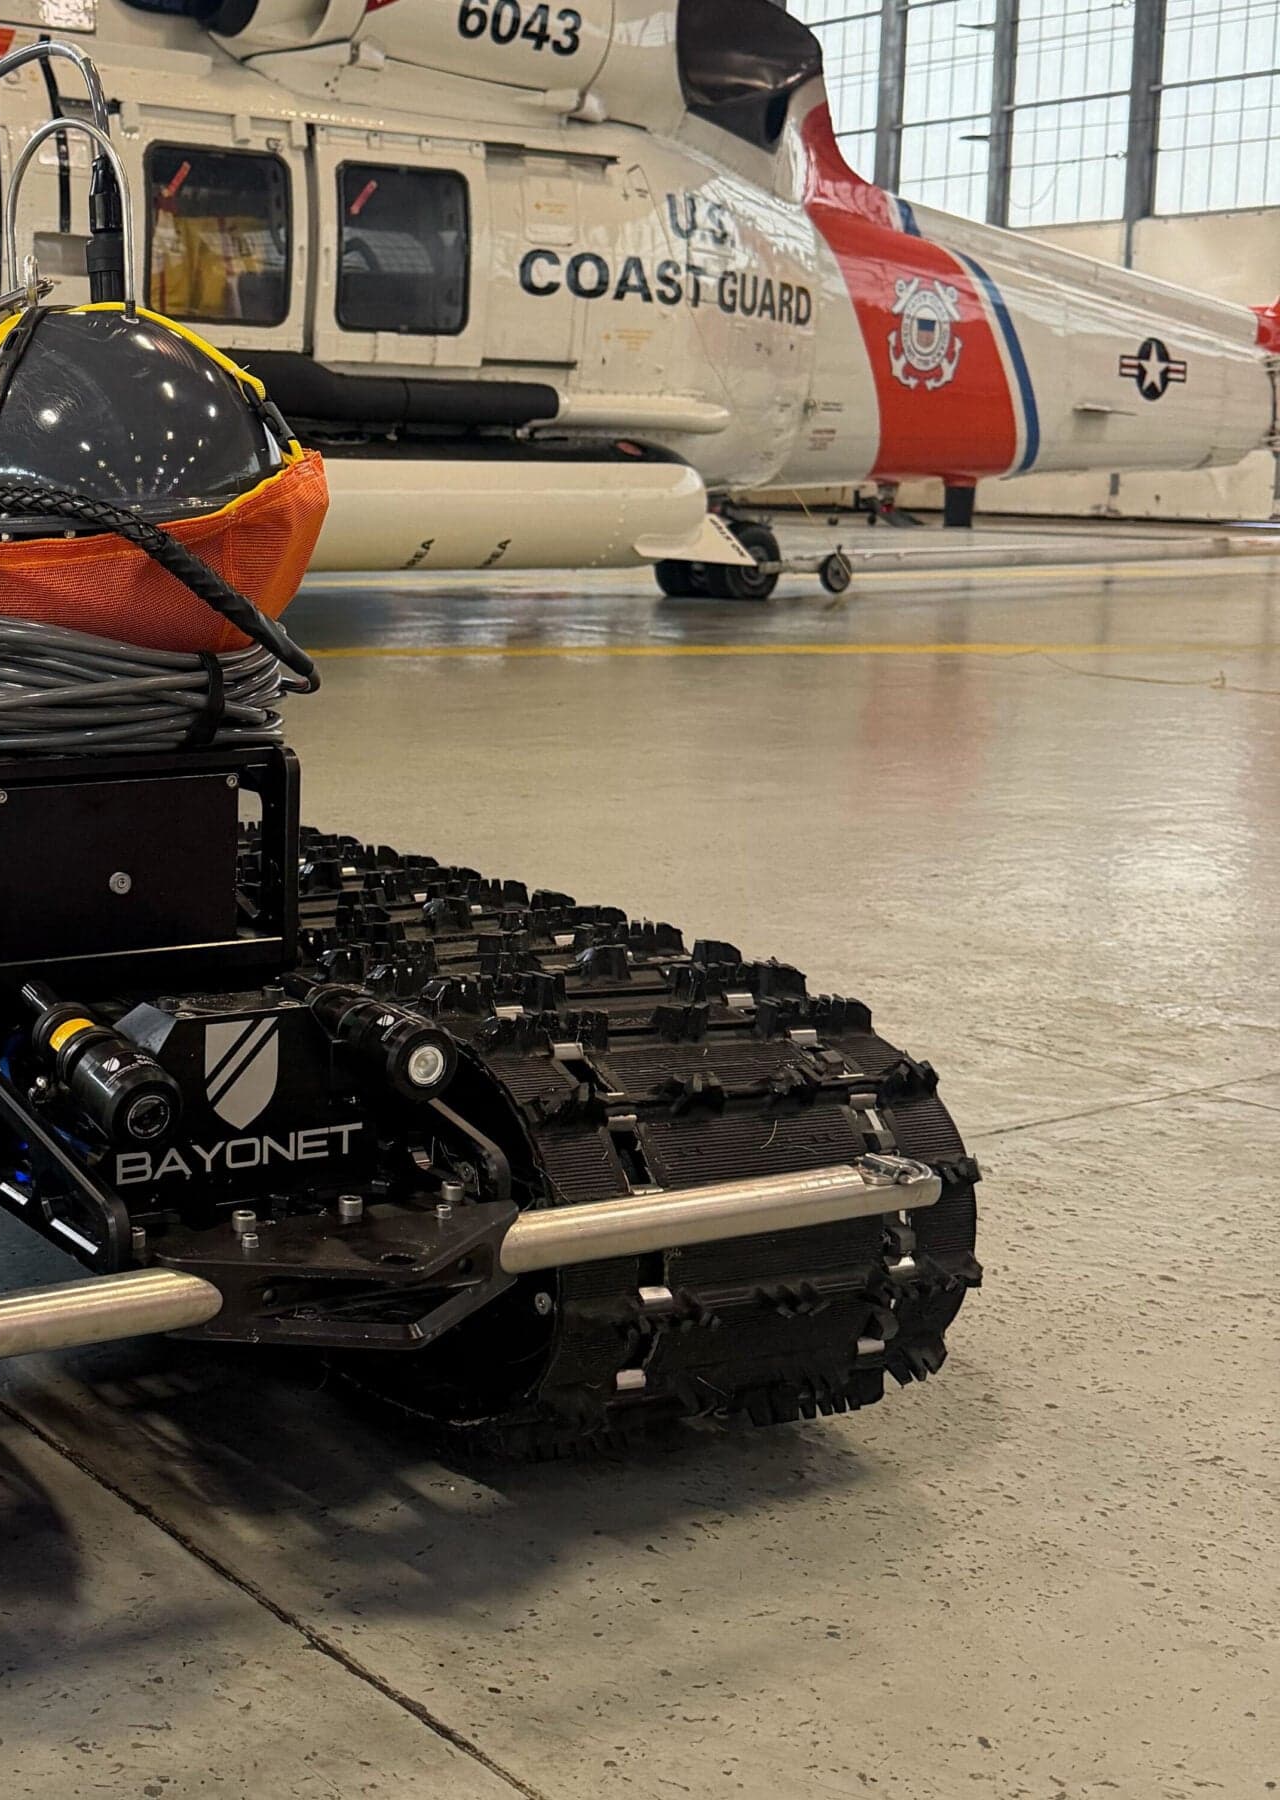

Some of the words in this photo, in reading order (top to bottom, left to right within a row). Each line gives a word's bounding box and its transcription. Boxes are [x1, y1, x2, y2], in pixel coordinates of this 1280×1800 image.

[458, 0, 582, 56] 6043
[666, 191, 736, 247] U.S.
[519, 248, 701, 308] COAST
[718, 269, 812, 327] GUARD
[116, 1122, 363, 1185] BAYONET
